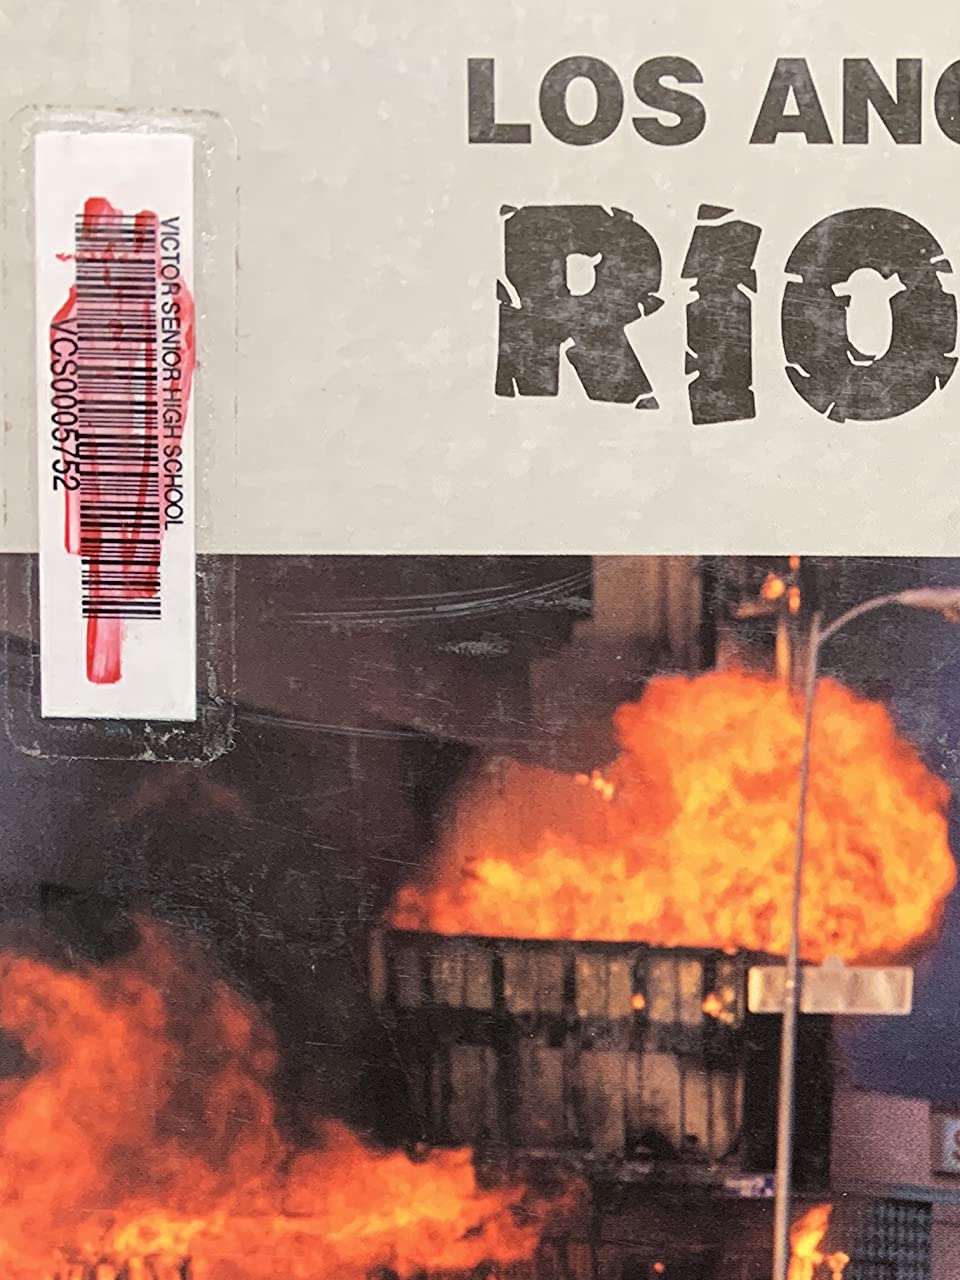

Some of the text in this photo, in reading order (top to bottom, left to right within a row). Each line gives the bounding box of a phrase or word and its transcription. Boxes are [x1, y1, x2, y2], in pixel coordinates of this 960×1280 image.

[465, 55, 708, 147] LOS
[50, 318, 81, 491] VCS0005752
[160, 216, 184, 531] VICTOR SENIOR HIGH SCHOOL
